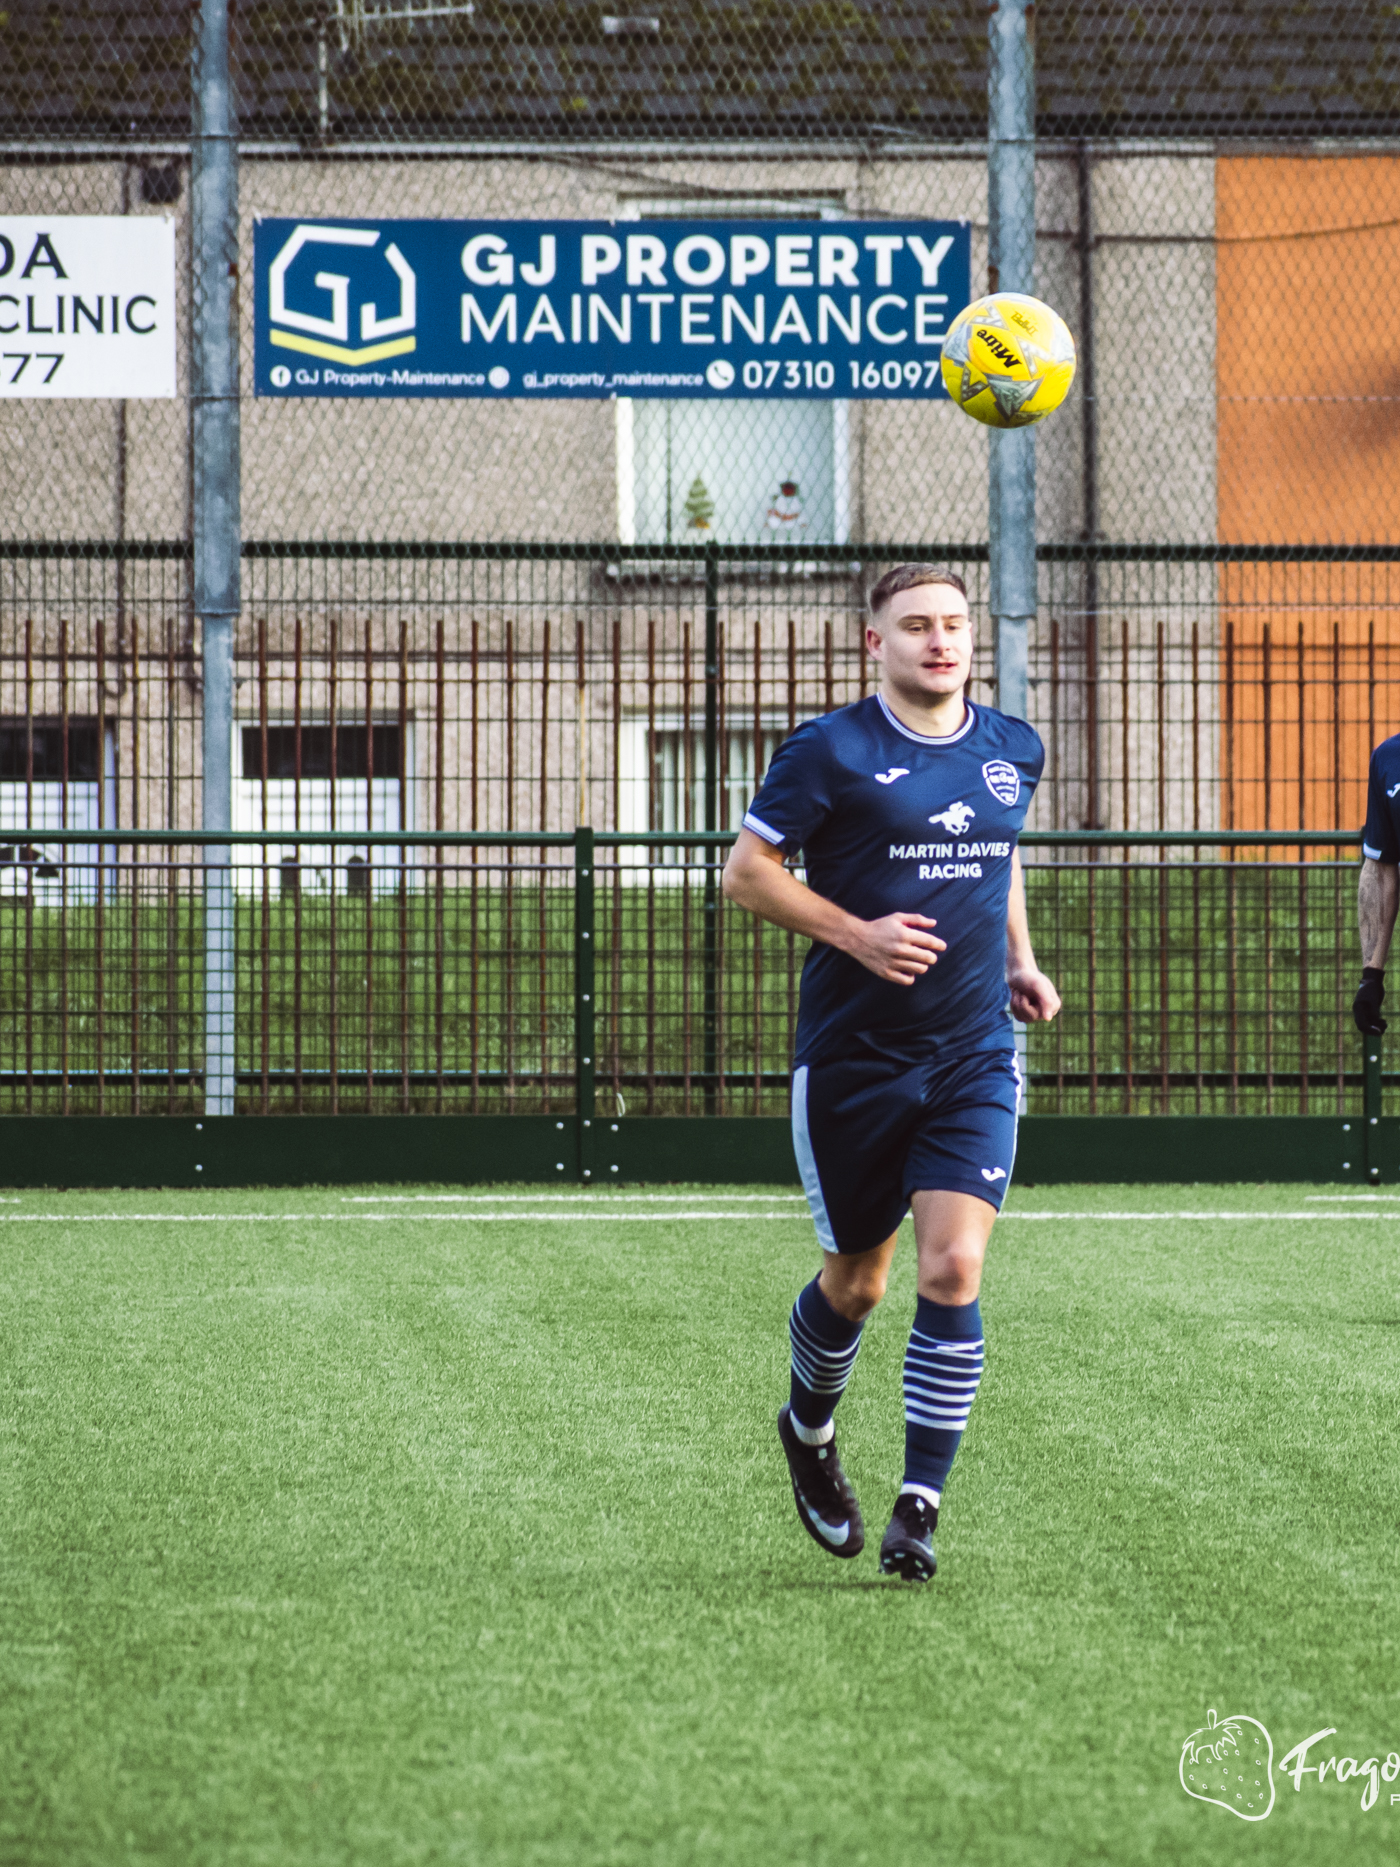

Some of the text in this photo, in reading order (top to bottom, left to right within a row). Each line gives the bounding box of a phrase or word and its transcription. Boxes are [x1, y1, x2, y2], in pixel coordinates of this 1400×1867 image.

[461, 233, 956, 287] GJ PROPERTY
[0, 294, 157, 334] CLINIC
[461, 293, 949, 344] MAINTENANCE
[977, 329, 1021, 368] Mitre
[0, 353, 65, 384] 77
[294, 368, 320, 385] GJ
[742, 359, 948, 390] 07310 16097
[889, 842, 1010, 859] MARTIN DAVIES
[919, 862, 982, 880] RACING
